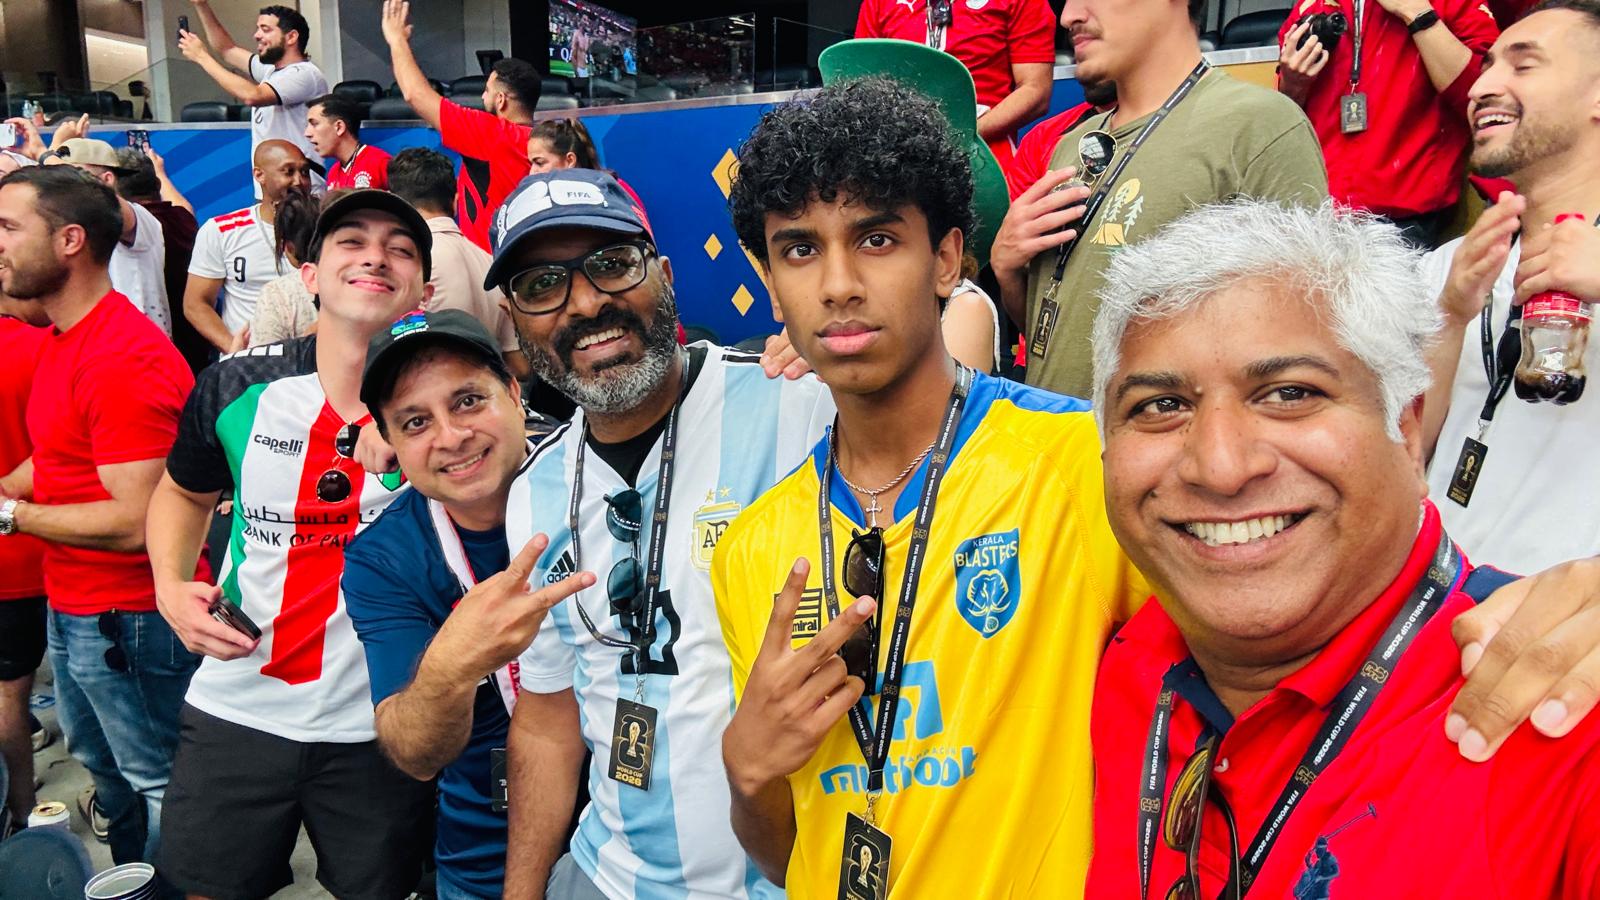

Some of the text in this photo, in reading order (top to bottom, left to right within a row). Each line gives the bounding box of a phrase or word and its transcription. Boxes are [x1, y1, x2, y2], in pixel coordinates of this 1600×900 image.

[567, 191, 591, 199] FIFA
[233, 256, 247, 283] 9
[254, 434, 304, 454] capelli
[273, 448, 301, 458] SPORT
[244, 522, 281, 547] BANK
[973, 535, 1004, 548] KERALA
[793, 619, 818, 631] miral
[1382, 586, 1436, 661] FIFA WORLD CUP 2026
[1155, 710, 1164, 736] 2026
[1313, 685, 1368, 766] FIFA WORLD CUP 2026
[1153, 735, 1161, 750] CUP
[1150, 750, 1159, 775] WORLD
[615, 771, 642, 787] 2026
[1250, 789, 1299, 866] FIFA WORLD CUP 2026
